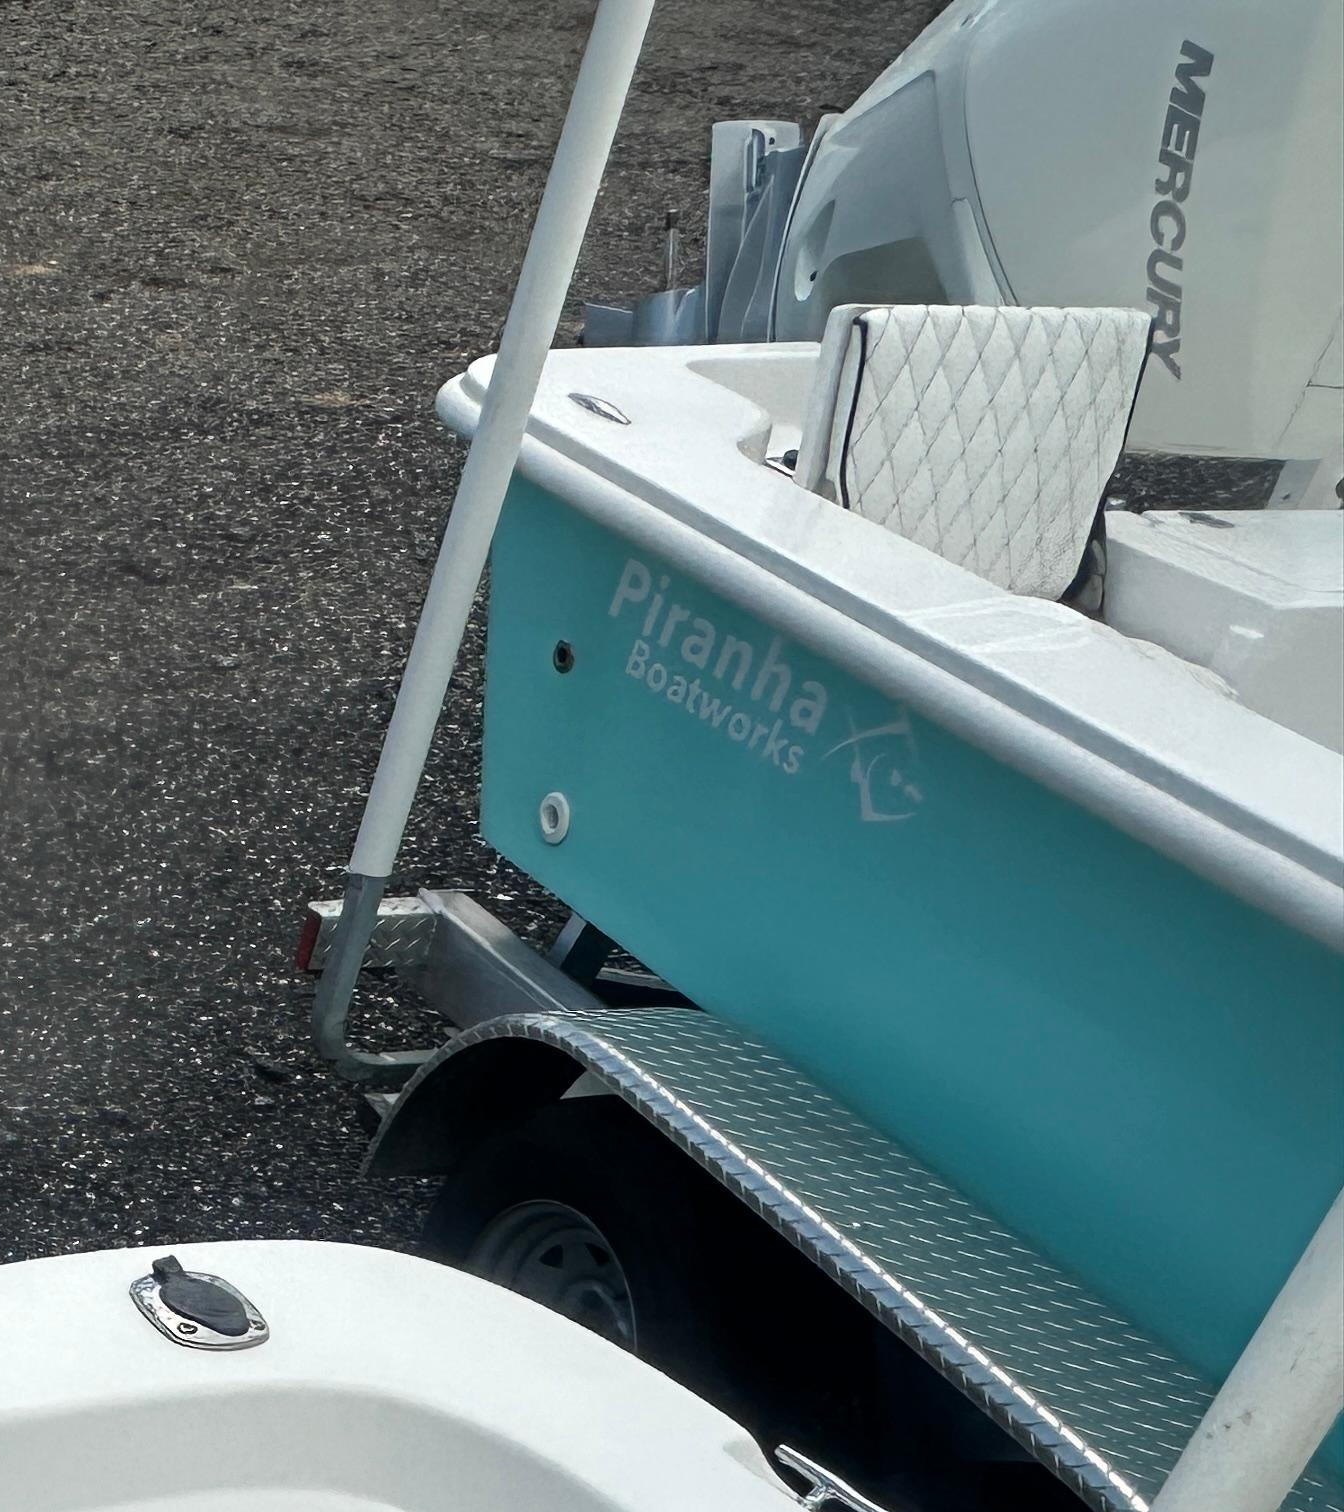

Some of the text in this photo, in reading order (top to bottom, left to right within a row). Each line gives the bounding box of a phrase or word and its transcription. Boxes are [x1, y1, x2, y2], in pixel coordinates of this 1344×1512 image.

[1146, 39, 1214, 380] MERCURY
[608, 558, 828, 733] Piranha
[625, 638, 805, 775] Boatworks
